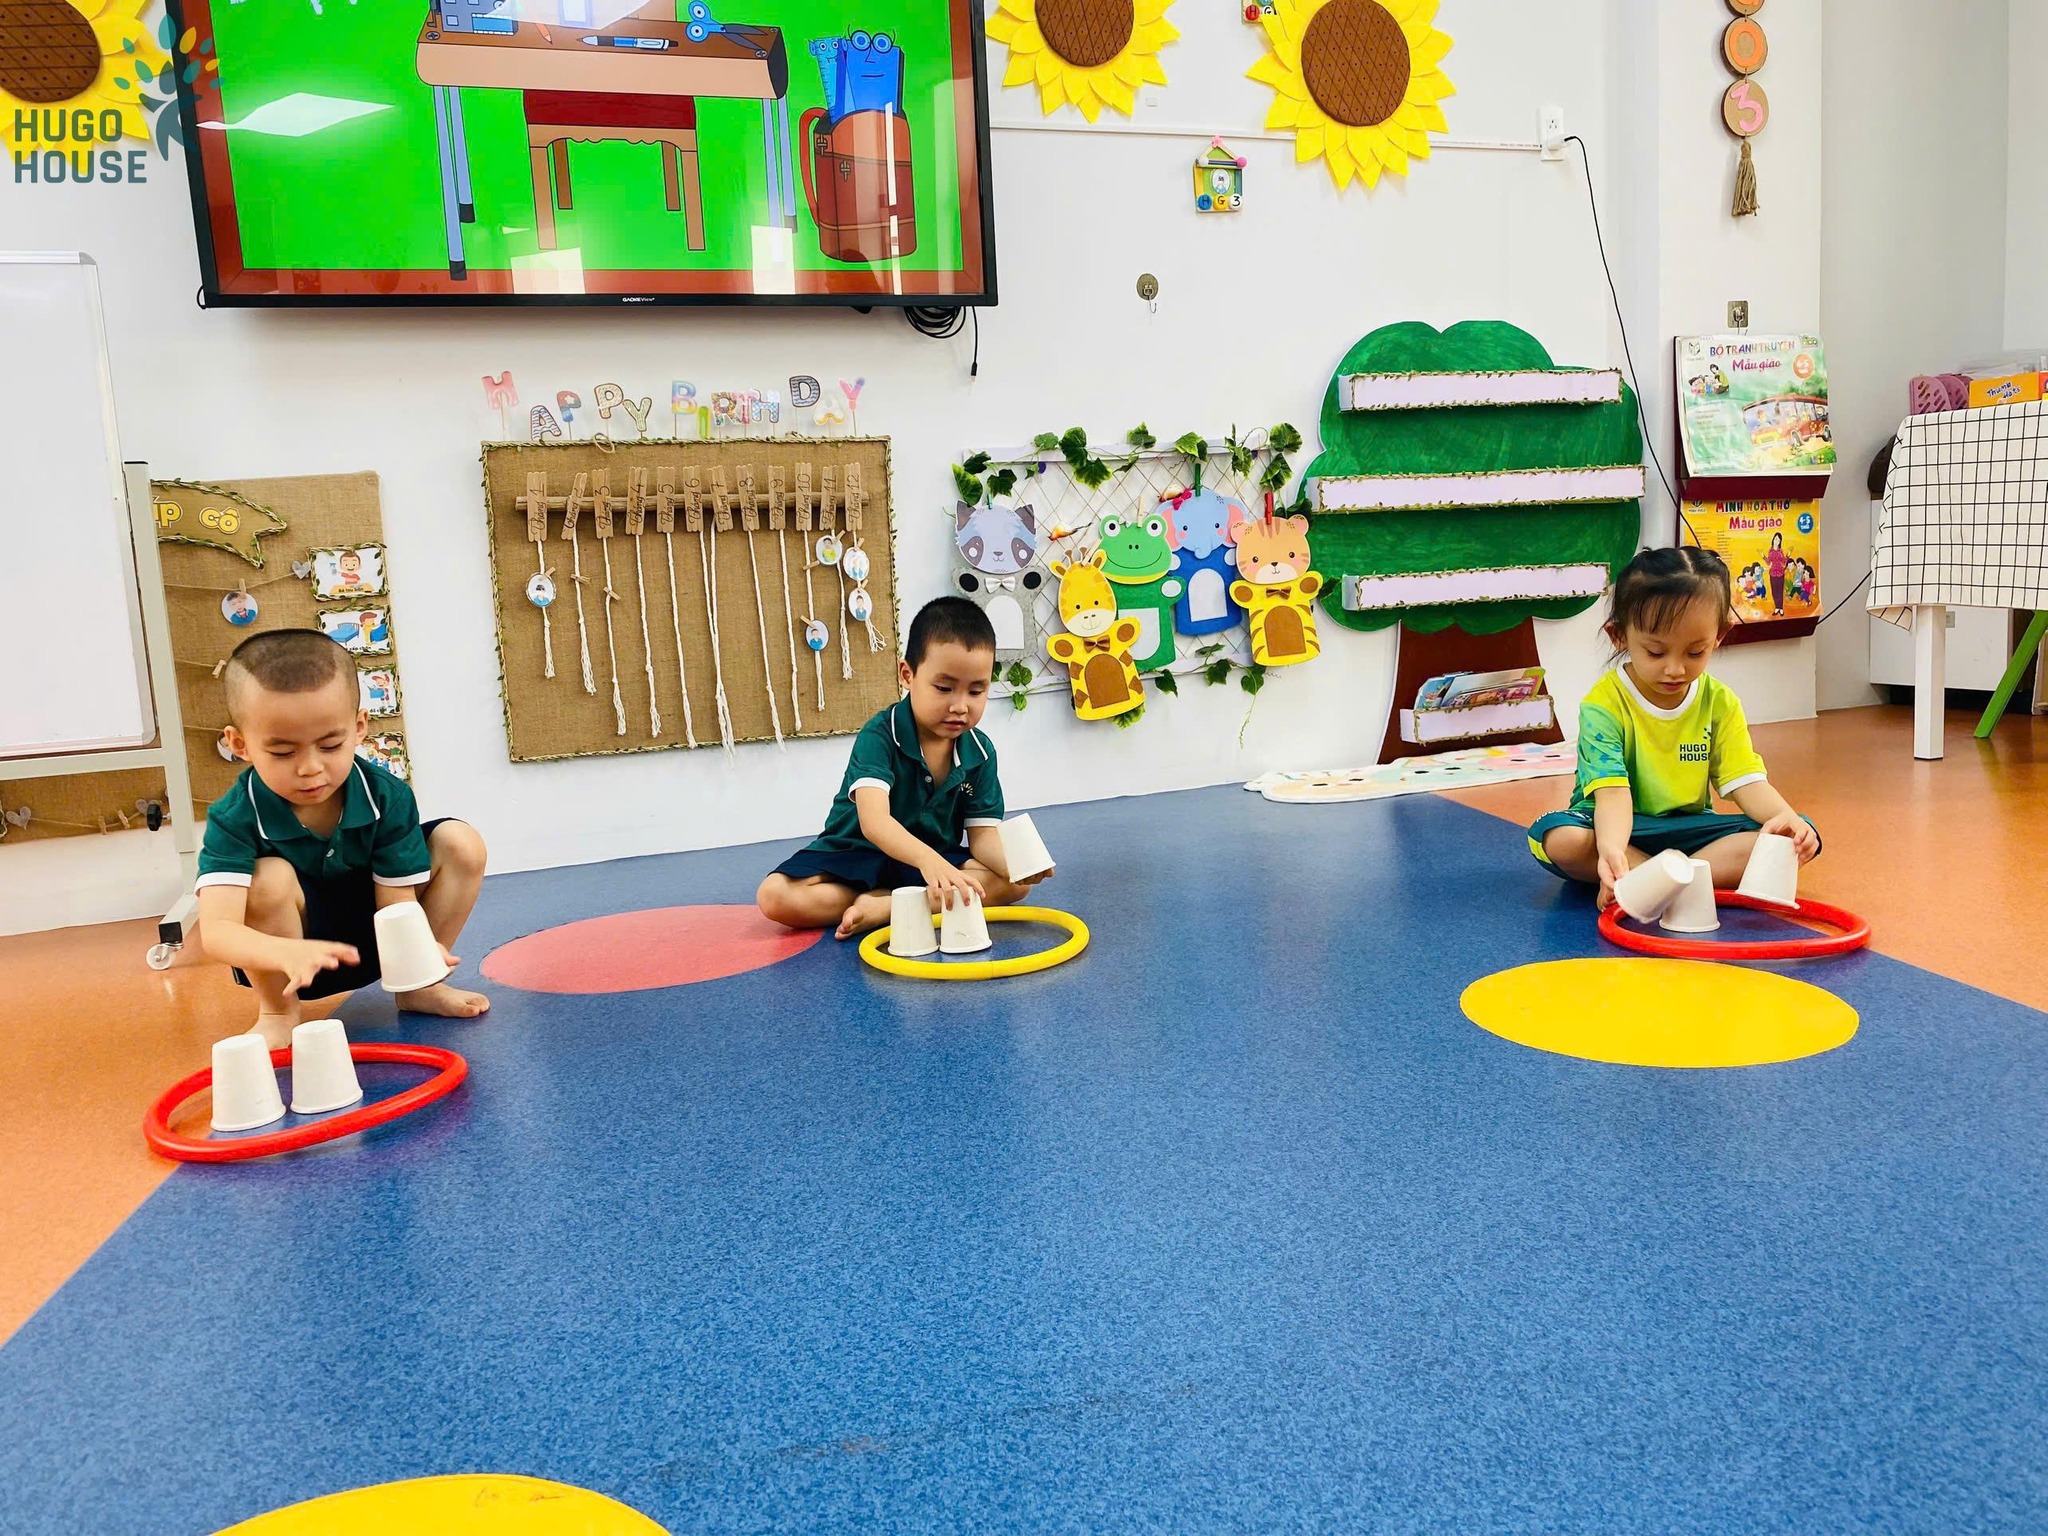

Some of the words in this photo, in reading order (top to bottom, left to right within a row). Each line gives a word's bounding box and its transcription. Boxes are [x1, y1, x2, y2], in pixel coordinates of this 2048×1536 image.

[1759, 358, 1782, 373] giáo
[482, 371, 652, 440] HAPPY
[630, 482, 644, 494] 4
[685, 478, 700, 488] 6
[711, 481, 724, 491] 7
[739, 476, 754, 488] 8
[770, 478, 784, 489] 9
[797, 473, 811, 492] 10
[823, 475, 837, 491] 11
[846, 474, 860, 492] 12
[530, 484, 545, 496] 1
[595, 485, 610, 496] 3
[658, 484, 674, 494] 5
[1715, 501, 1743, 512] MINH
[1757, 515, 1782, 531] giáo
[1680, 744, 1707, 752] HUGO
